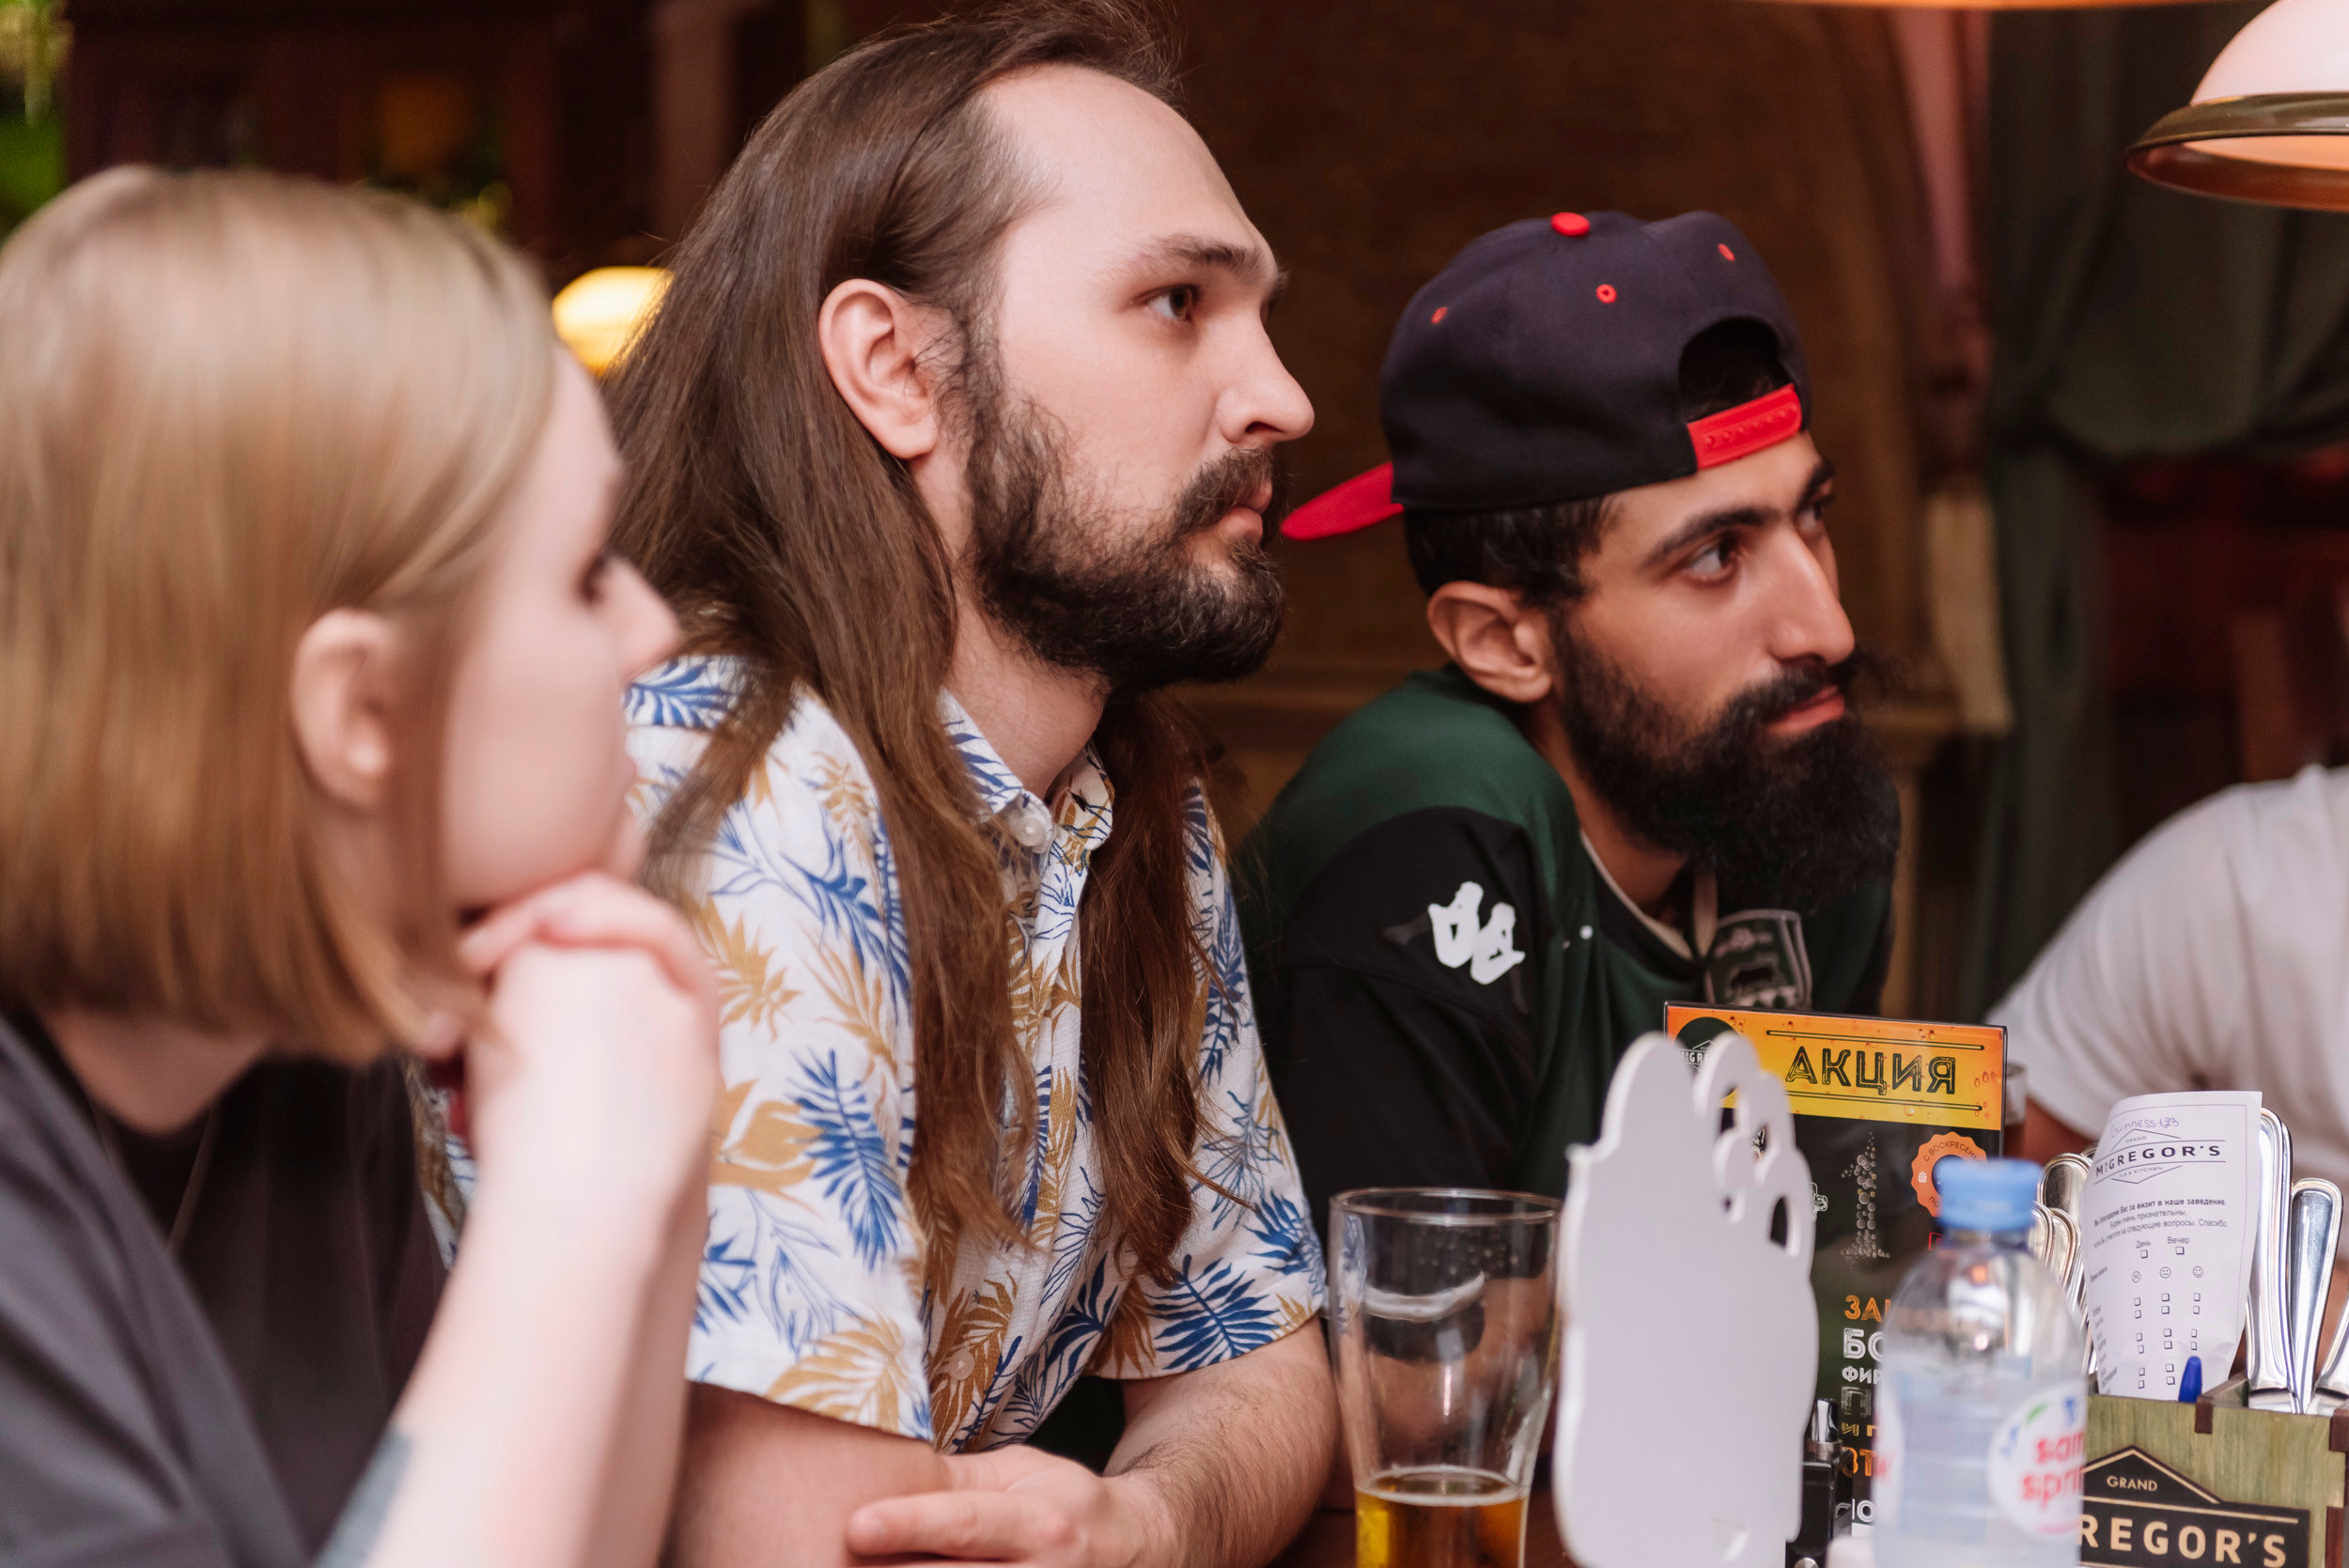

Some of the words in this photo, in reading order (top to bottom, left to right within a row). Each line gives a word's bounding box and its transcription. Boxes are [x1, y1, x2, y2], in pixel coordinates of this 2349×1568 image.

[1785, 1046, 1956, 1096] АКЦИЯ
[2137, 1201, 2156, 1210] визит
[2136, 1240, 2152, 1249] День
[2167, 1236, 2190, 1245] Вечер
[2106, 1475, 2158, 1492] GRAND
